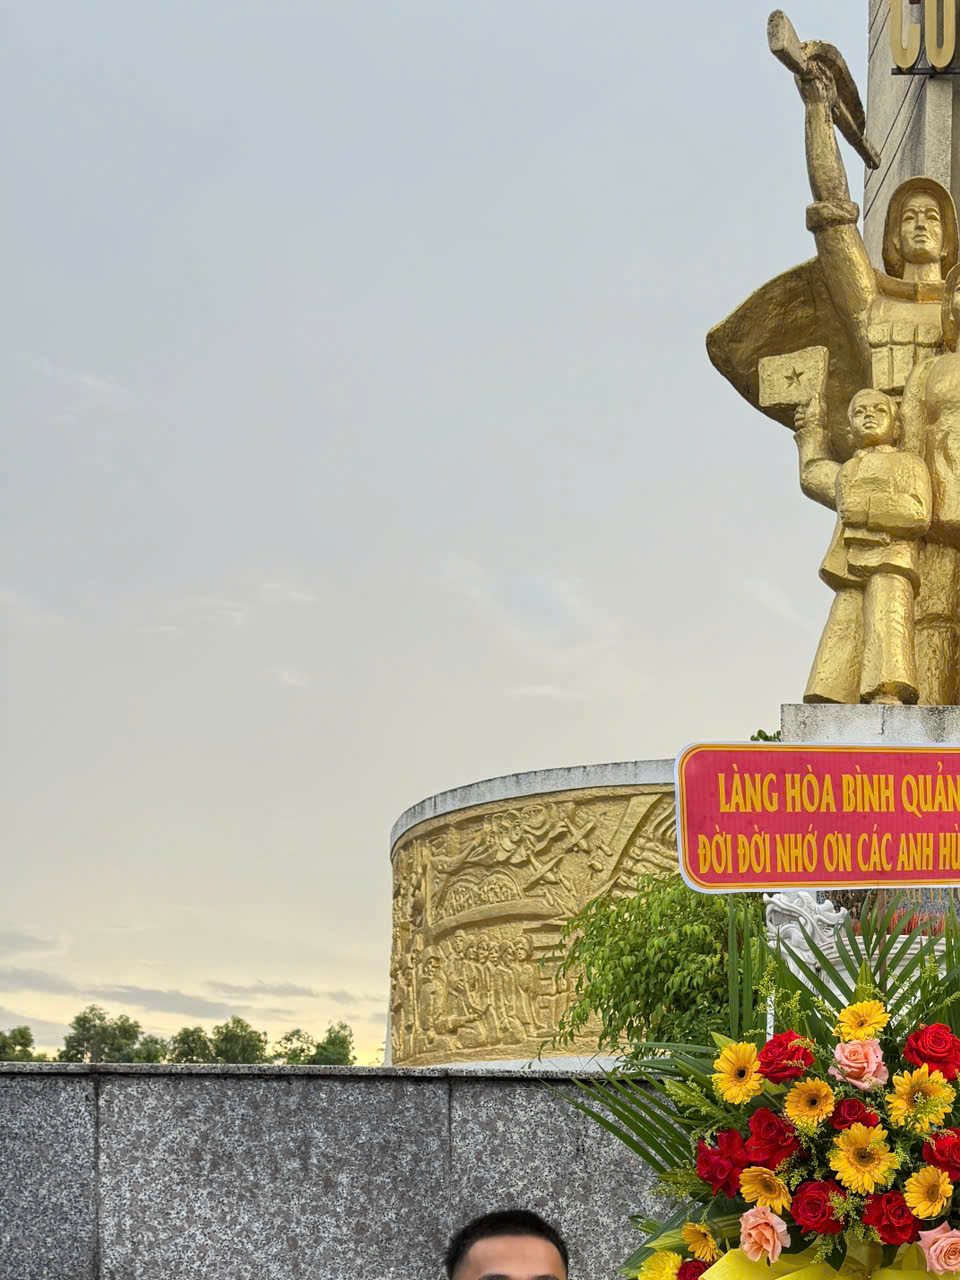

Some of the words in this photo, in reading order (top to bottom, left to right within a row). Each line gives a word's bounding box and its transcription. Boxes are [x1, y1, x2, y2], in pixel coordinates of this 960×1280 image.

[717, 763, 779, 813] LÀNG
[785, 764, 837, 813] HÒA
[841, 765, 896, 813] BÌNH
[697, 824, 733, 874] ĐỜI
[737, 824, 771, 873] ĐỜI
[775, 823, 818, 873] NHỚ
[823, 831, 852, 873] ƠN
[857, 823, 892, 872] CÁC
[896, 832, 934, 871] ANH
